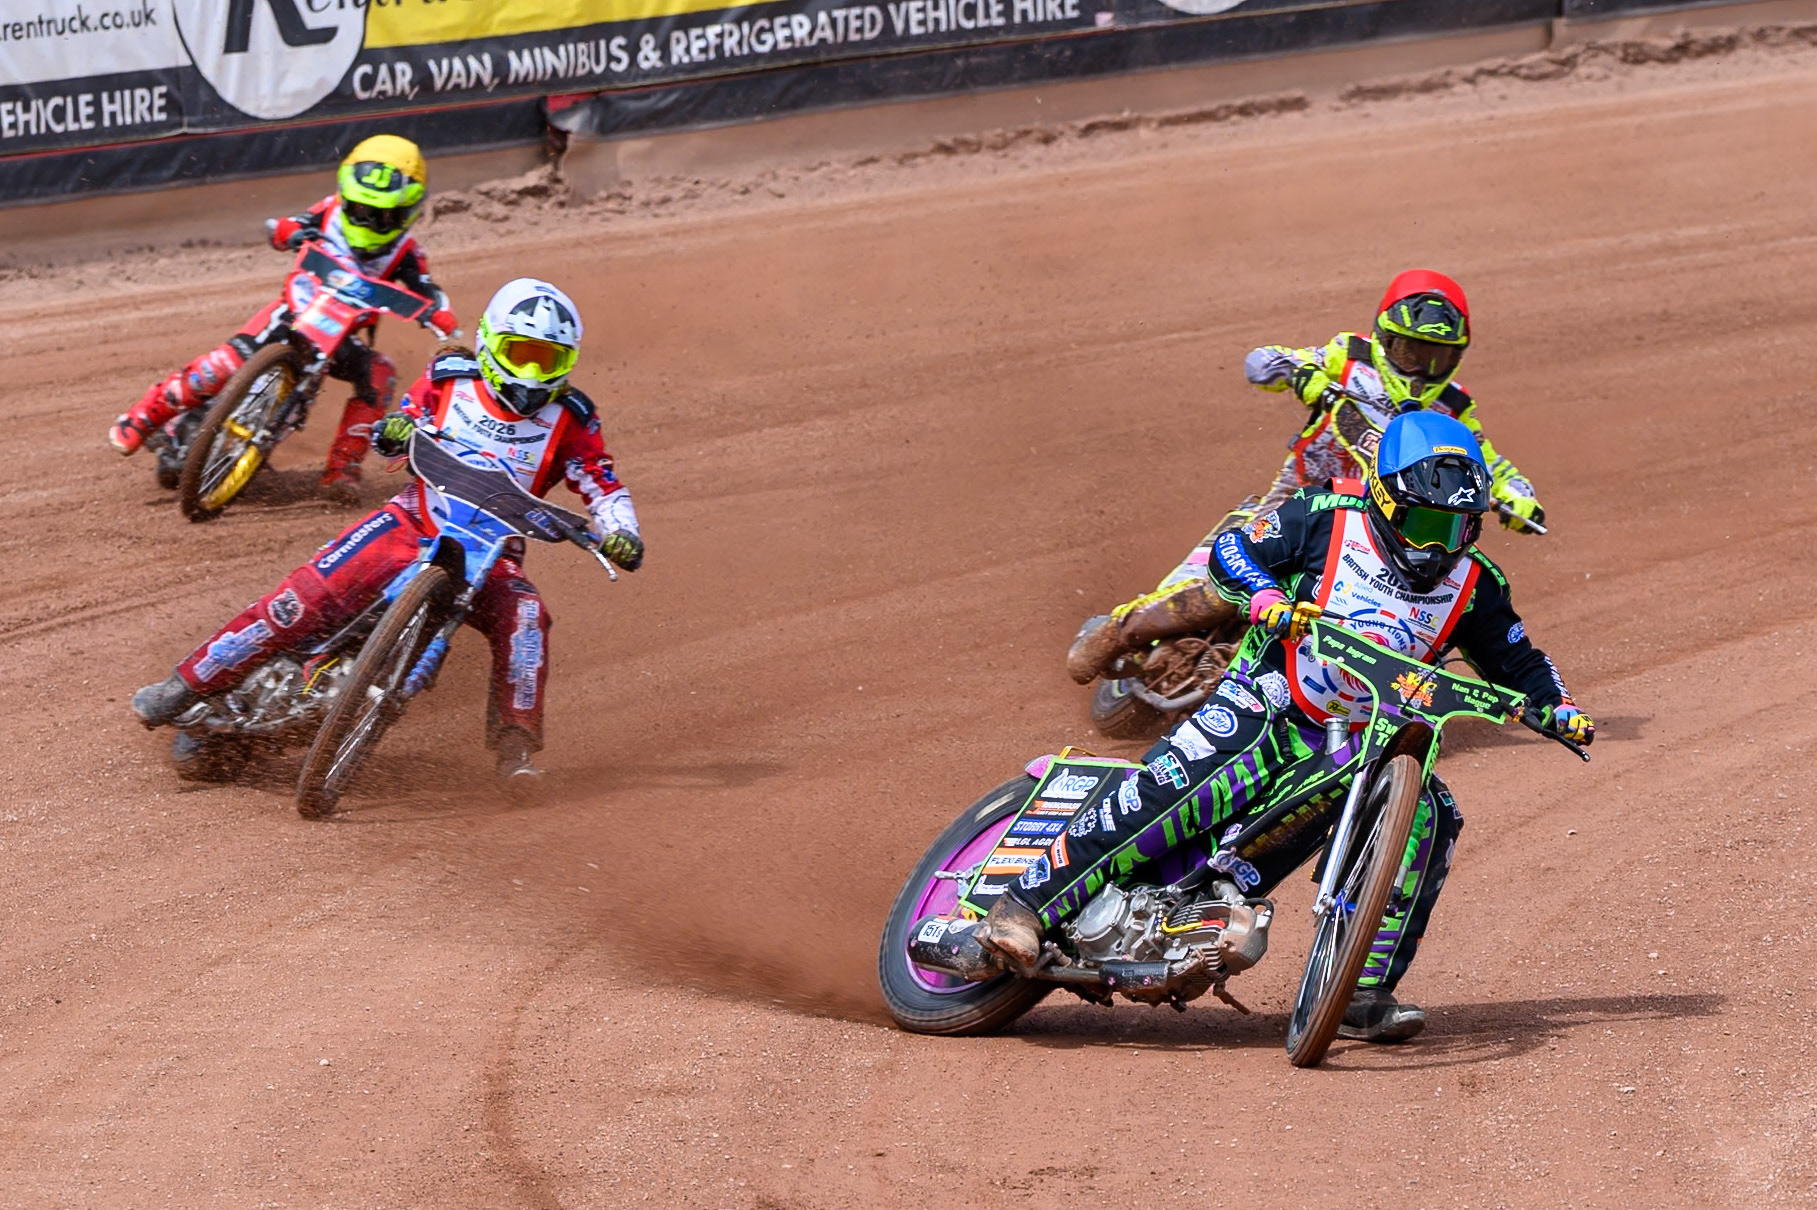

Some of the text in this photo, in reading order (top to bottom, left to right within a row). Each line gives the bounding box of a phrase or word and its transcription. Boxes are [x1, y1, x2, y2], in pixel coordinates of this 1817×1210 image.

[507, 35, 630, 84] MINIBUS
[637, 33, 663, 71] &
[670, 9, 883, 65] REFRIGERATED
[891, 0, 1005, 36] VEHICLE
[101, 85, 168, 127] HIRE
[479, 415, 516, 435] 2026
[1342, 554, 1454, 605] BRITISH YOUTH CHAMPIONSHIP
[1351, 592, 1381, 607] Vehicles
[1409, 607, 1441, 627] NSSC
[1323, 635, 1377, 664] Papa Ingram
[1451, 683, 1470, 695] Nan
[1464, 695, 1491, 710] Hague
[1062, 777, 1096, 792] RGP
